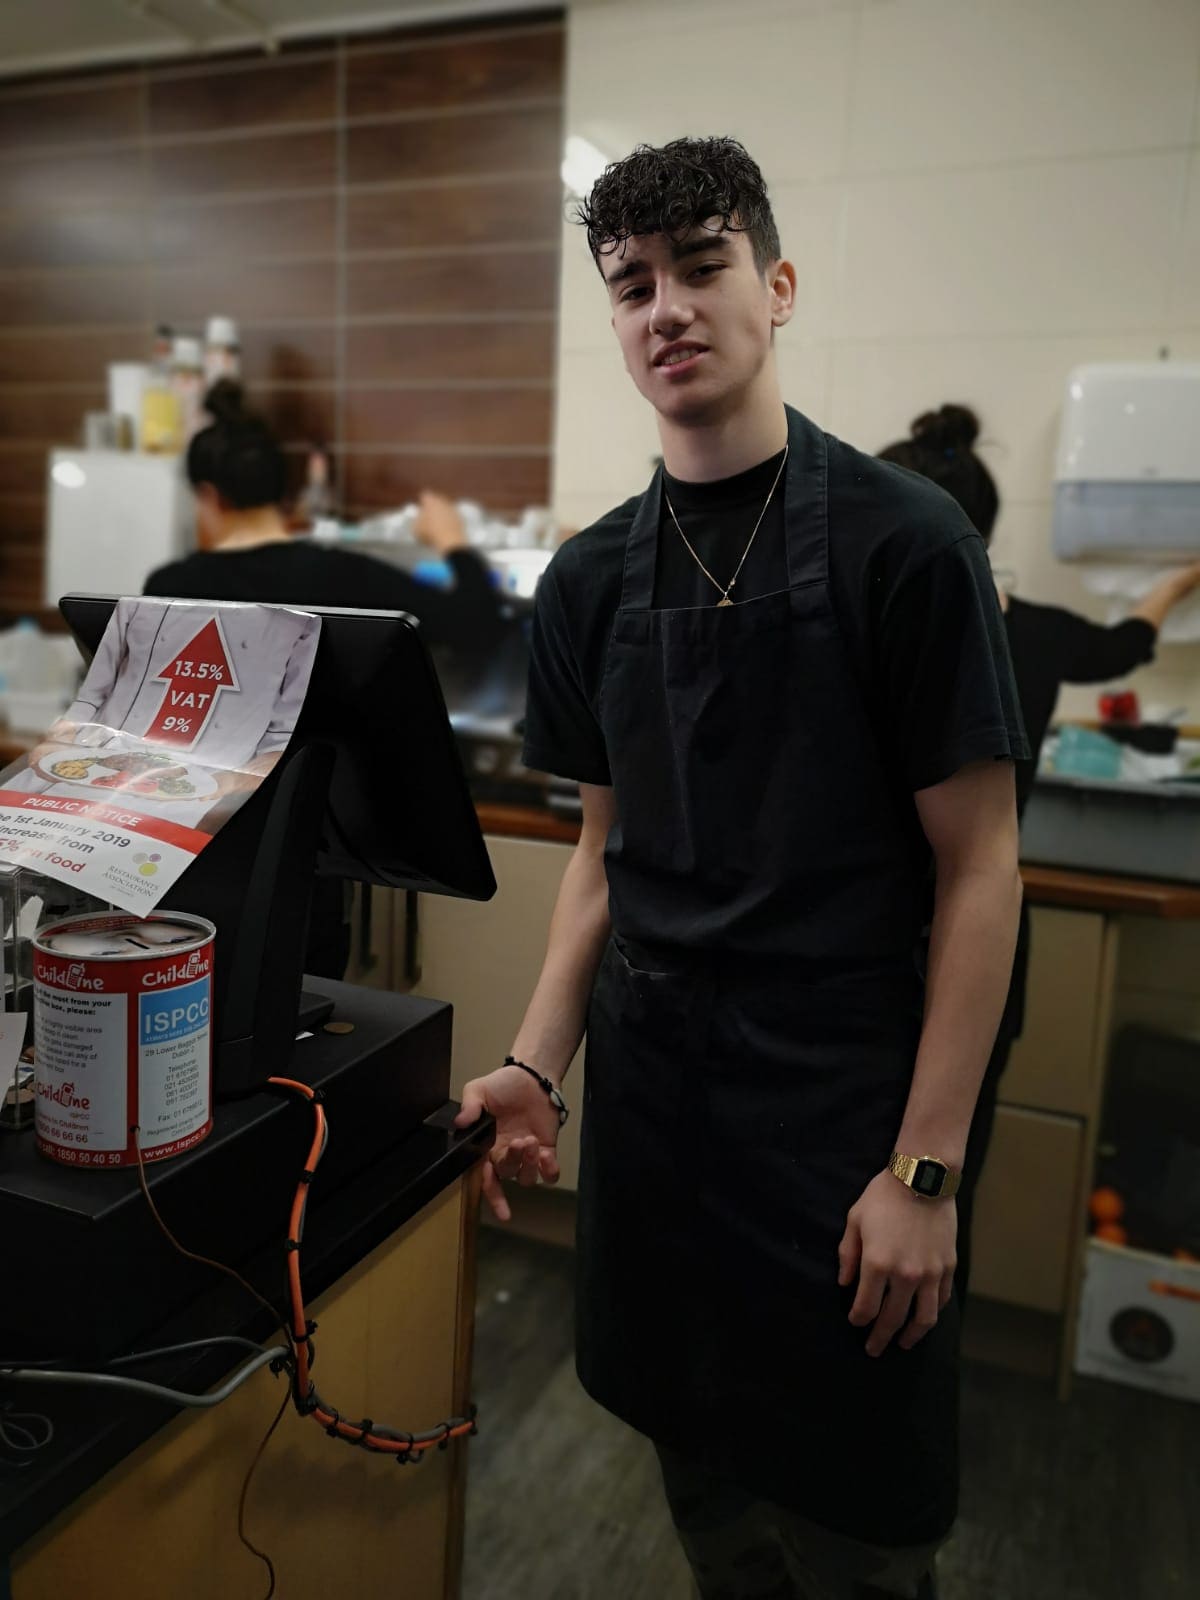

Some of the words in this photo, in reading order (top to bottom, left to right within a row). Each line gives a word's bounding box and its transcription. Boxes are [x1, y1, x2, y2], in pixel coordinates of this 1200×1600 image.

[174, 660, 224, 681] 13.5%
[170, 690, 210, 709] VAT
[161, 716, 192, 733] 9%
[23, 797, 79, 811] PUBLIC
[79, 804, 141, 827] NOTICE
[33, 818, 91, 836] January
[92, 830, 131, 848] 2019
[56, 835, 95, 854] from
[44, 852, 87, 873] food
[71, 997, 89, 1007] from
[92, 1000, 112, 1008] your
[145, 996, 209, 1034] ISPCC
[62, 1131, 74, 1142] 66
[75, 1134, 88, 1144] 66
[57, 1149, 76, 1161] 1850
[78, 1152, 90, 1163] 50
[92, 1154, 105, 1164] 40
[108, 1153, 121, 1164] 50
